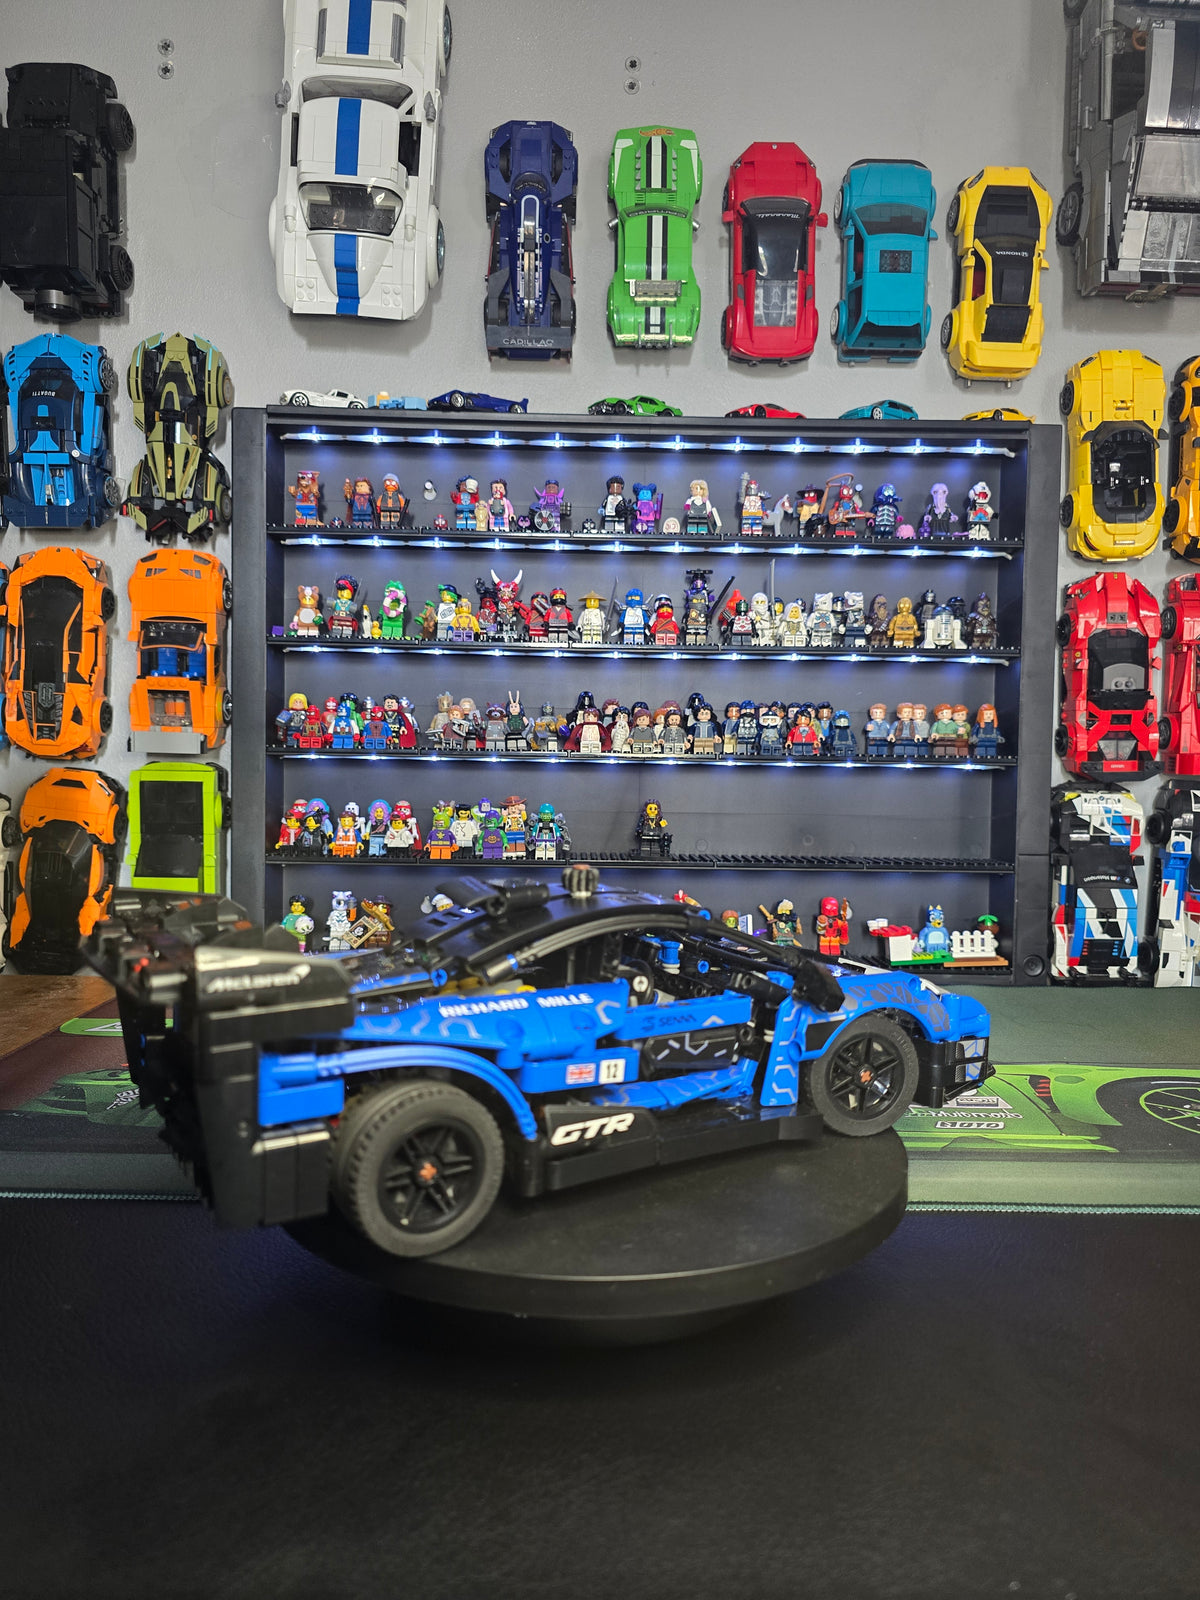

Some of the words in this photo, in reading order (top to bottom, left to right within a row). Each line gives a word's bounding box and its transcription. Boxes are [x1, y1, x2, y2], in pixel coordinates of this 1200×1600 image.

[502, 338, 554, 346] CADILLAC
[439, 997, 529, 1018] RICHARD
[536, 993, 594, 1008] MILLE
[606, 1062, 619, 1079] 12
[551, 1112, 635, 1146] GTR
